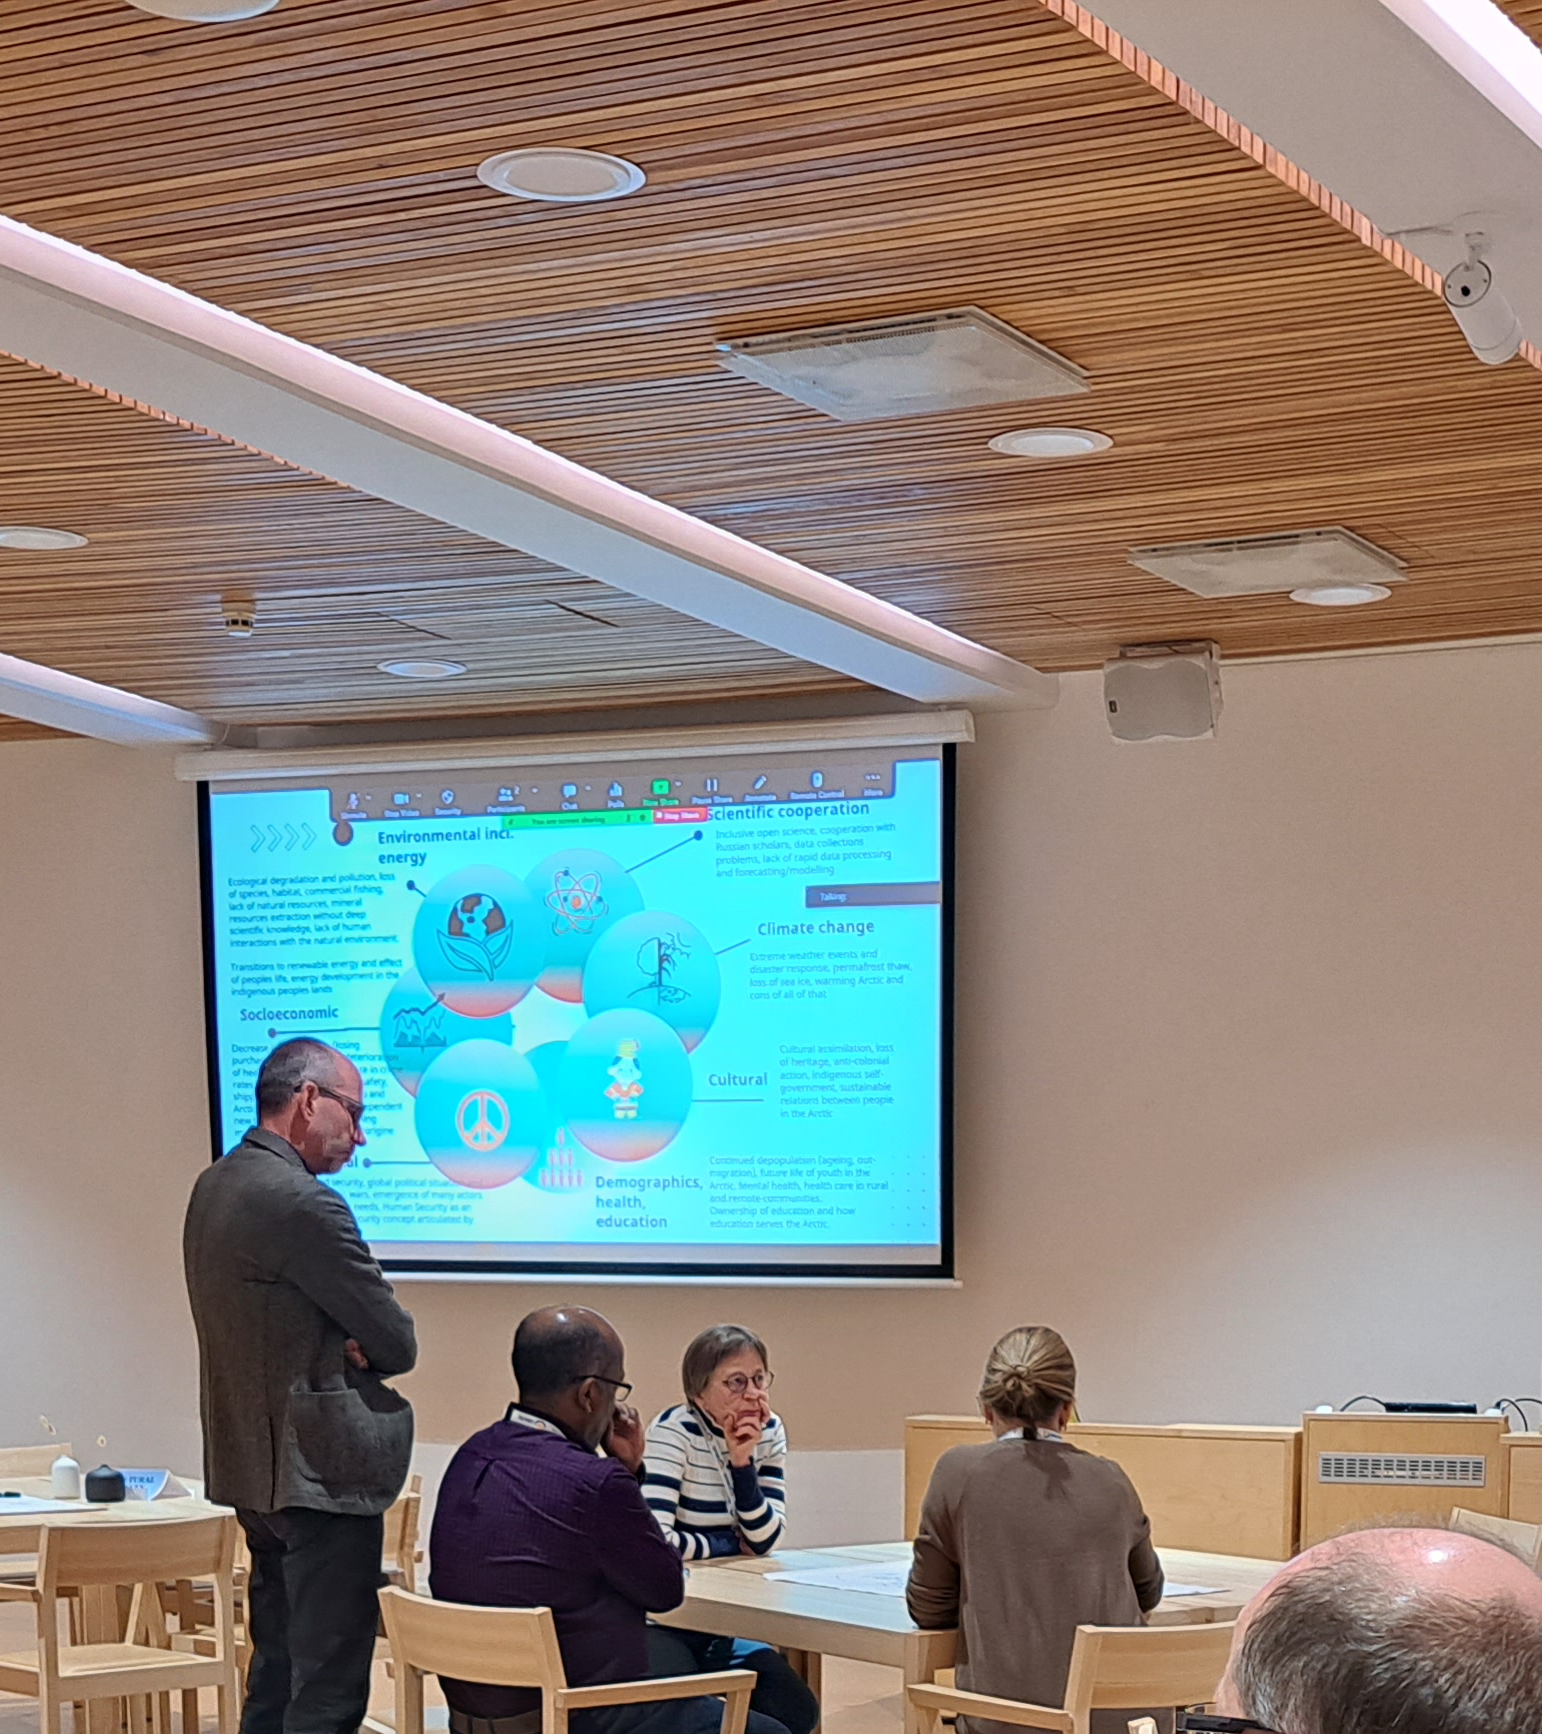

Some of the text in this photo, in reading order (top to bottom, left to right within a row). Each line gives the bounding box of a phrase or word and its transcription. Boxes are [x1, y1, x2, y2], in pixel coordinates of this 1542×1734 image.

[708, 802, 869, 821] Scientific cooperation
[378, 828, 481, 844] Environmental
[757, 830, 780, 839] open
[820, 824, 874, 835] cooperation
[876, 823, 896, 831] with
[794, 839, 814, 848] data
[817, 837, 864, 847] collections
[378, 852, 427, 866] energy
[763, 853, 780, 862] lack
[783, 853, 793, 862] of
[795, 851, 818, 863] rapid
[821, 851, 840, 860] data
[843, 850, 891, 860] processing
[716, 865, 834, 878] and forecasting/modelling
[228, 878, 267, 888] Ecological
[270, 875, 319, 886] degradation
[322, 874, 336, 882] and
[228, 890, 237, 898] of
[305, 886, 351, 895] commercial
[247, 902, 255, 910] of
[257, 901, 285, 909] natural
[271, 913, 310, 921] extraction
[313, 912, 343, 920] without
[346, 911, 366, 920] deep
[230, 926, 264, 935] scientific
[332, 923, 340, 931] of
[758, 920, 874, 936] Climate change
[230, 939, 277, 947] interactions
[314, 936, 342, 944] natural
[789, 951, 825, 959] weather
[828, 951, 858, 959] events
[861, 949, 878, 958] and
[231, 963, 274, 971] Transitions
[331, 962, 358, 970] energy
[750, 965, 784, 973] disaster
[833, 962, 885, 974] permafrost
[231, 975, 239, 983] of
[321, 973, 373, 982] development
[750, 979, 766, 987] loss
[769, 978, 778, 986] of
[815, 978, 856, 987] warming
[858, 976, 884, 984] Arctic
[886, 975, 903, 984] and
[231, 988, 275, 998] indigenous
[773, 990, 781, 999] of
[797, 990, 805, 998] of
[240, 1005, 339, 1021] Socioeconomic
[780, 1058, 789, 1066] of
[709, 1072, 768, 1086] Cultural
[840, 1082, 891, 1092] sustainable
[822, 1096, 860, 1104] between
[863, 1096, 894, 1106] people
[808, 1109, 833, 1118] Arctic
[368, 1178, 391, 1188] global
[595, 1175, 703, 1192] Demographics,
[596, 1195, 645, 1210] health,
[596, 1215, 667, 1228] education
